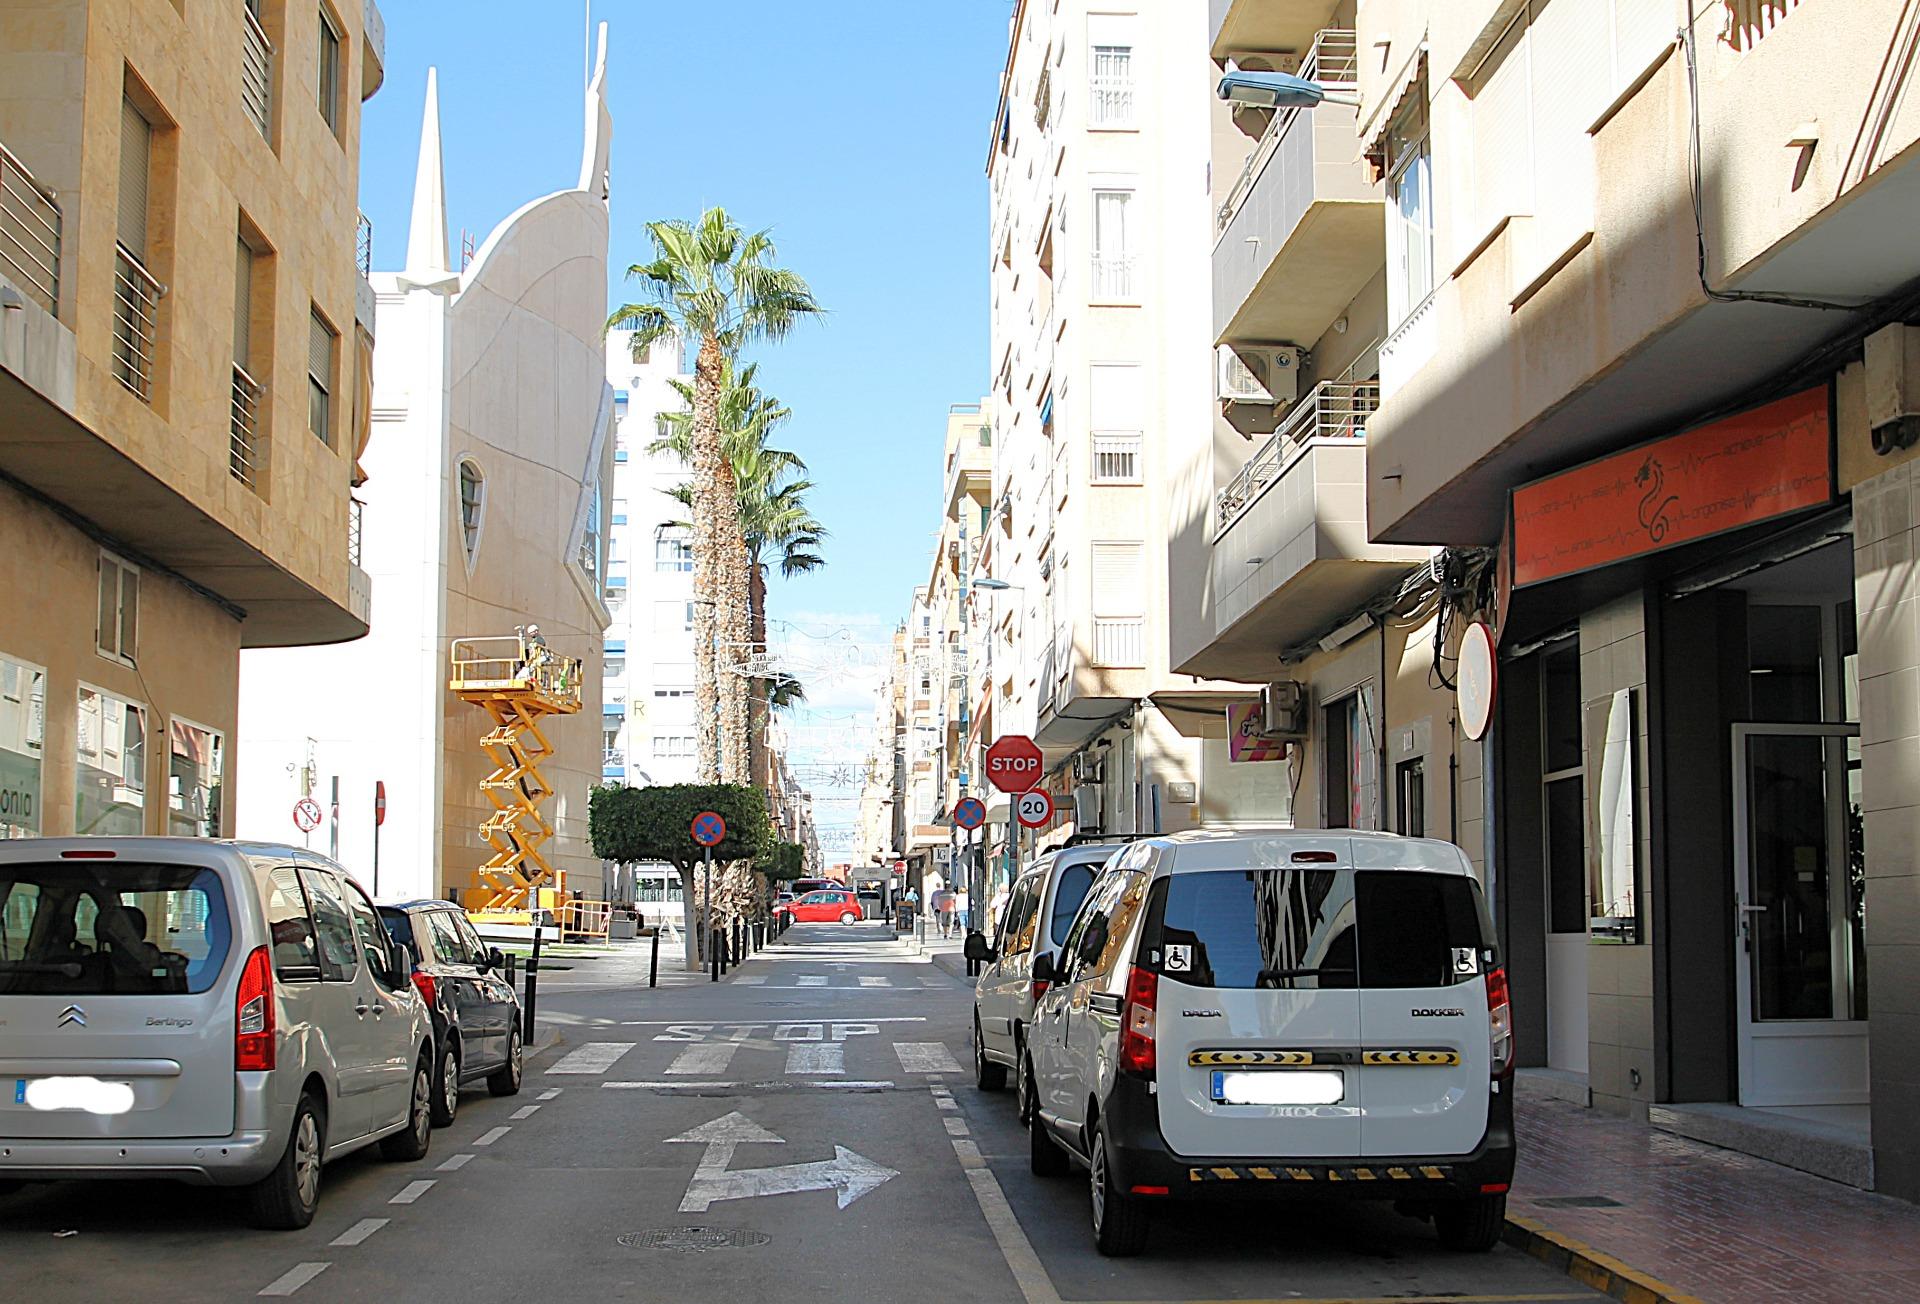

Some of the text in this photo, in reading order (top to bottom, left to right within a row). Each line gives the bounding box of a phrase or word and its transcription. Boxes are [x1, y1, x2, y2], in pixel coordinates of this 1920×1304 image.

[991, 758, 1038, 771] STOP
[1022, 801, 1045, 814] 20
[1182, 1009, 1222, 1018] DACIA
[1411, 1008, 1465, 1017] DOKKER
[145, 1017, 194, 1028] Berlingo
[652, 1023, 880, 1041] STOP
